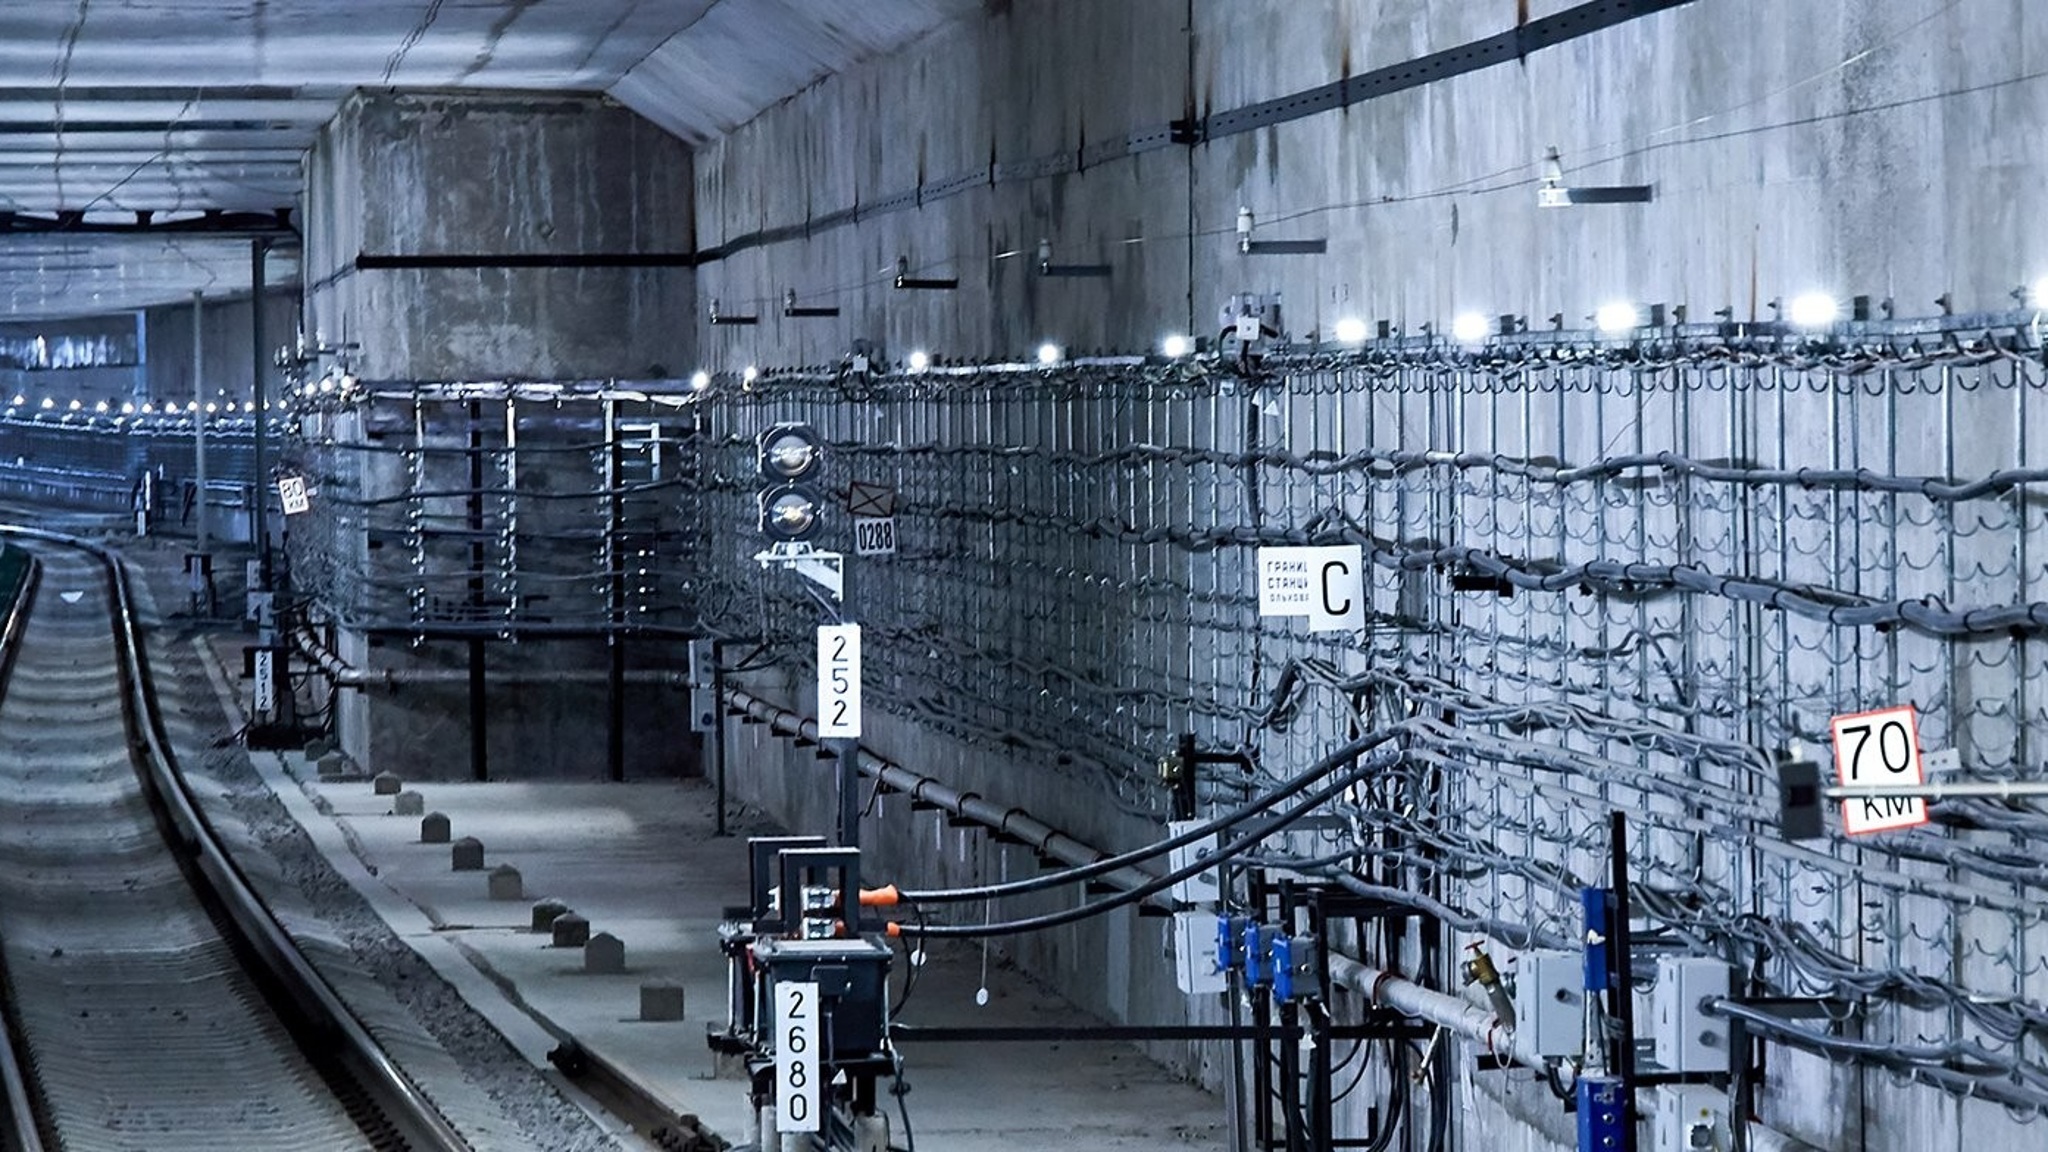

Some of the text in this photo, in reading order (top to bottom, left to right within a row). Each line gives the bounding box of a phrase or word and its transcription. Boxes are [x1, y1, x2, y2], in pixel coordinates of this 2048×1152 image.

[282, 480, 303, 498] 80
[858, 521, 894, 551] 0288
[831, 635, 849, 727] 252
[1841, 720, 1911, 780] 70
[787, 990, 808, 1122] 2680
